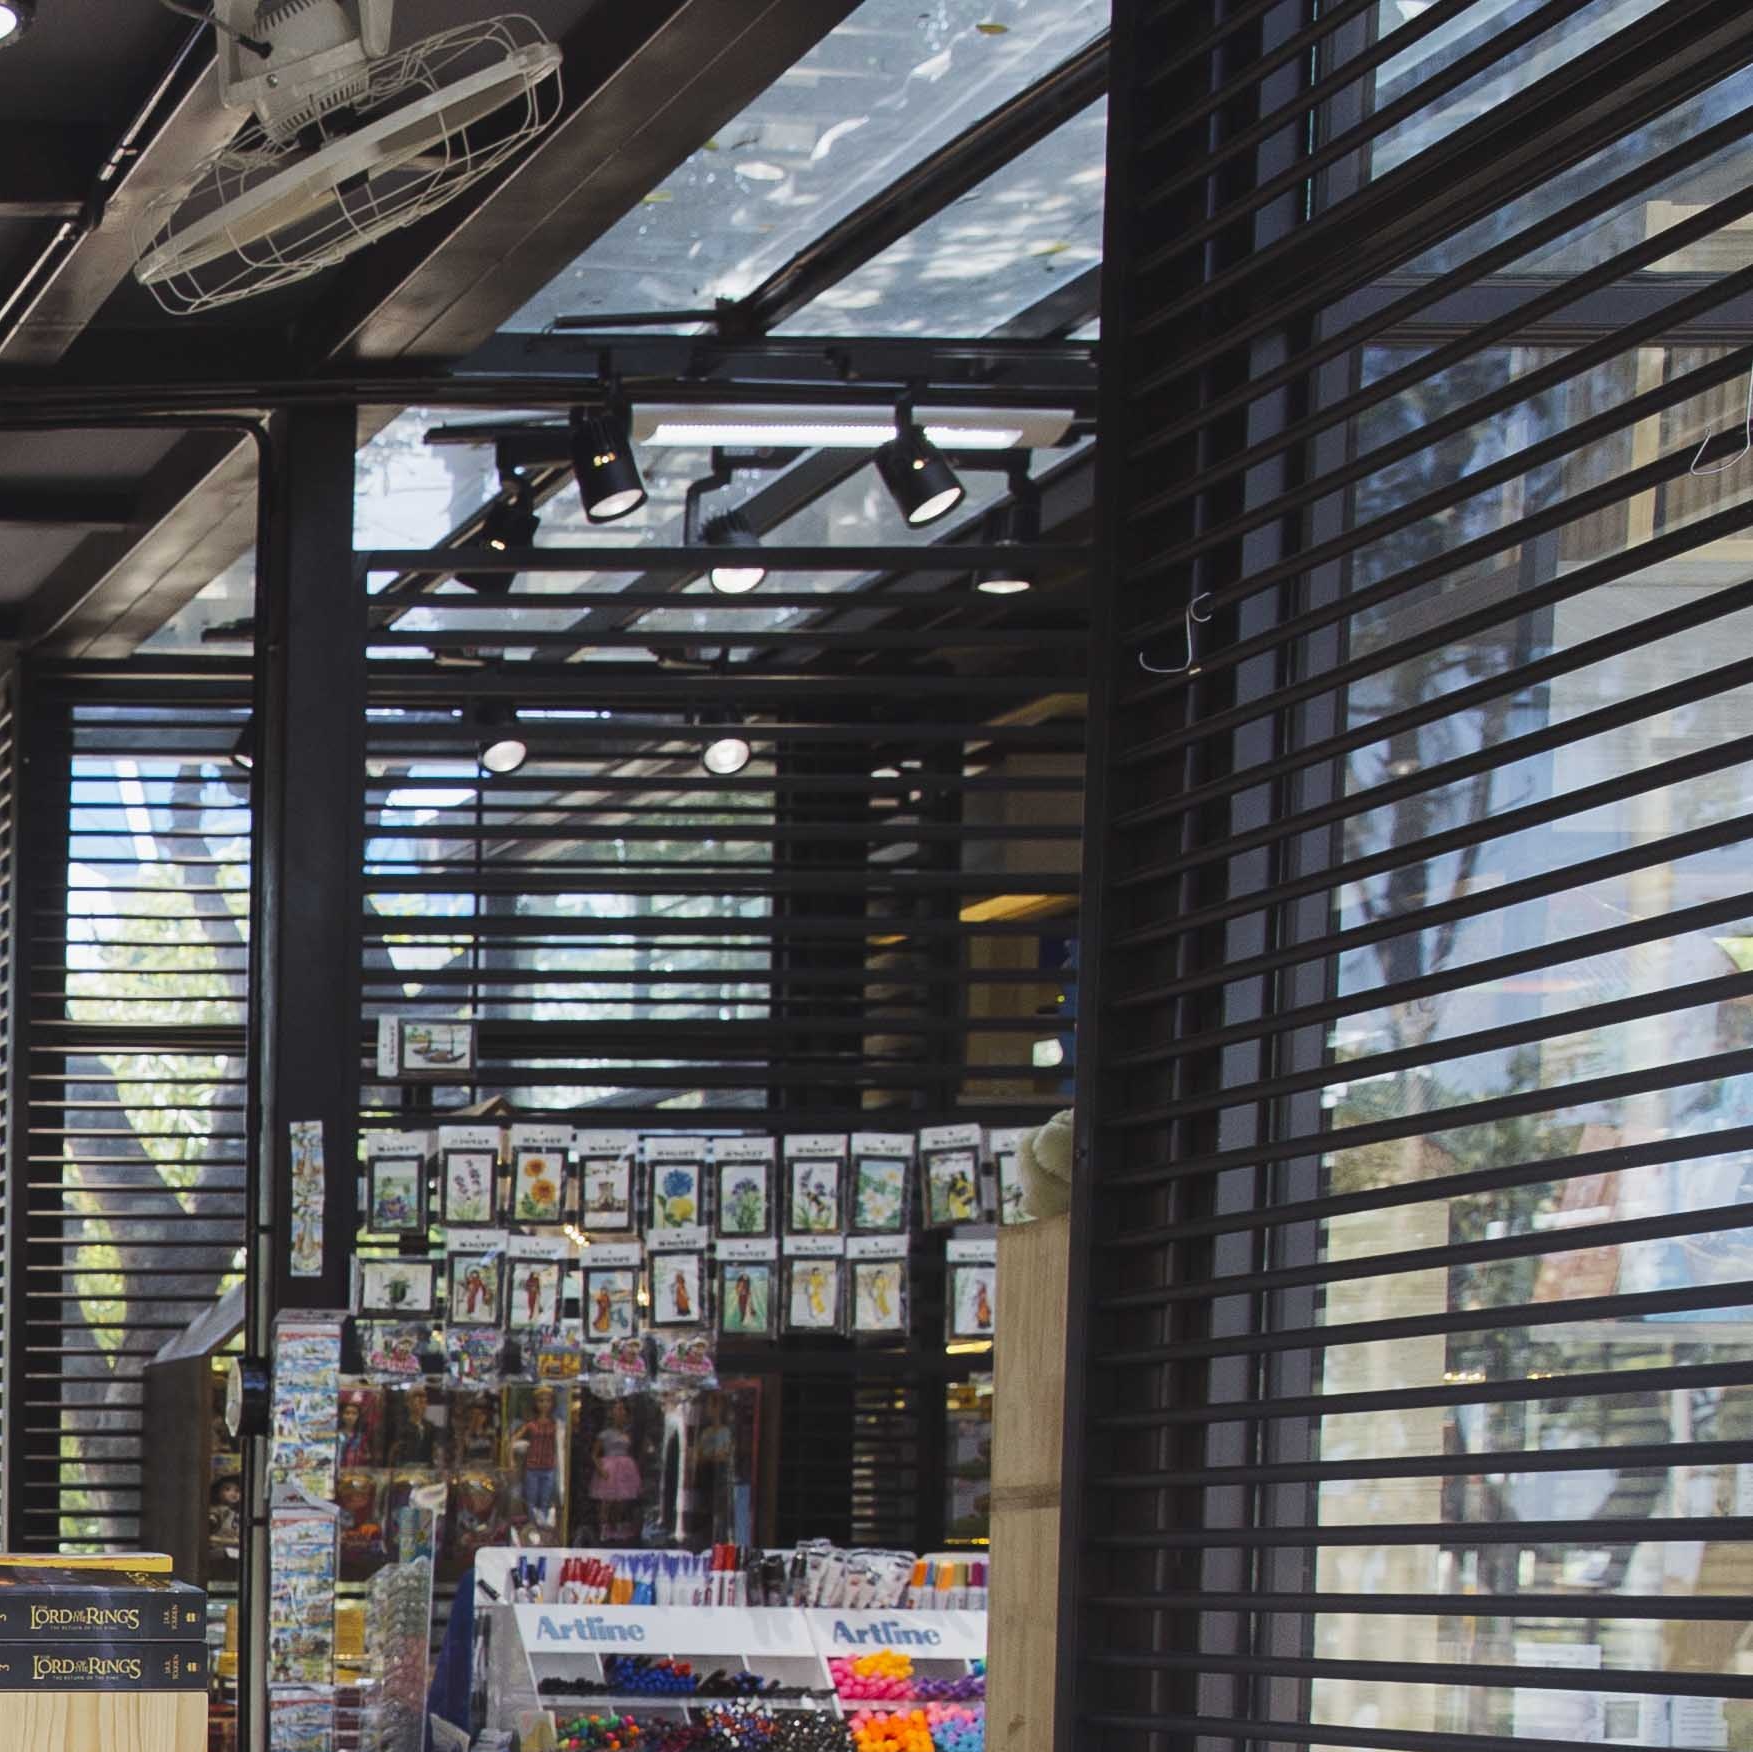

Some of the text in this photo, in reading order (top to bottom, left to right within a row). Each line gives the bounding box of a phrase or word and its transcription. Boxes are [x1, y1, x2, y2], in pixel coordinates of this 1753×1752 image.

[30, 1605, 74, 1630] LORD
[86, 1607, 140, 1630] RINGS
[536, 1615, 645, 1641] Artline
[833, 1620, 941, 1646] Artline
